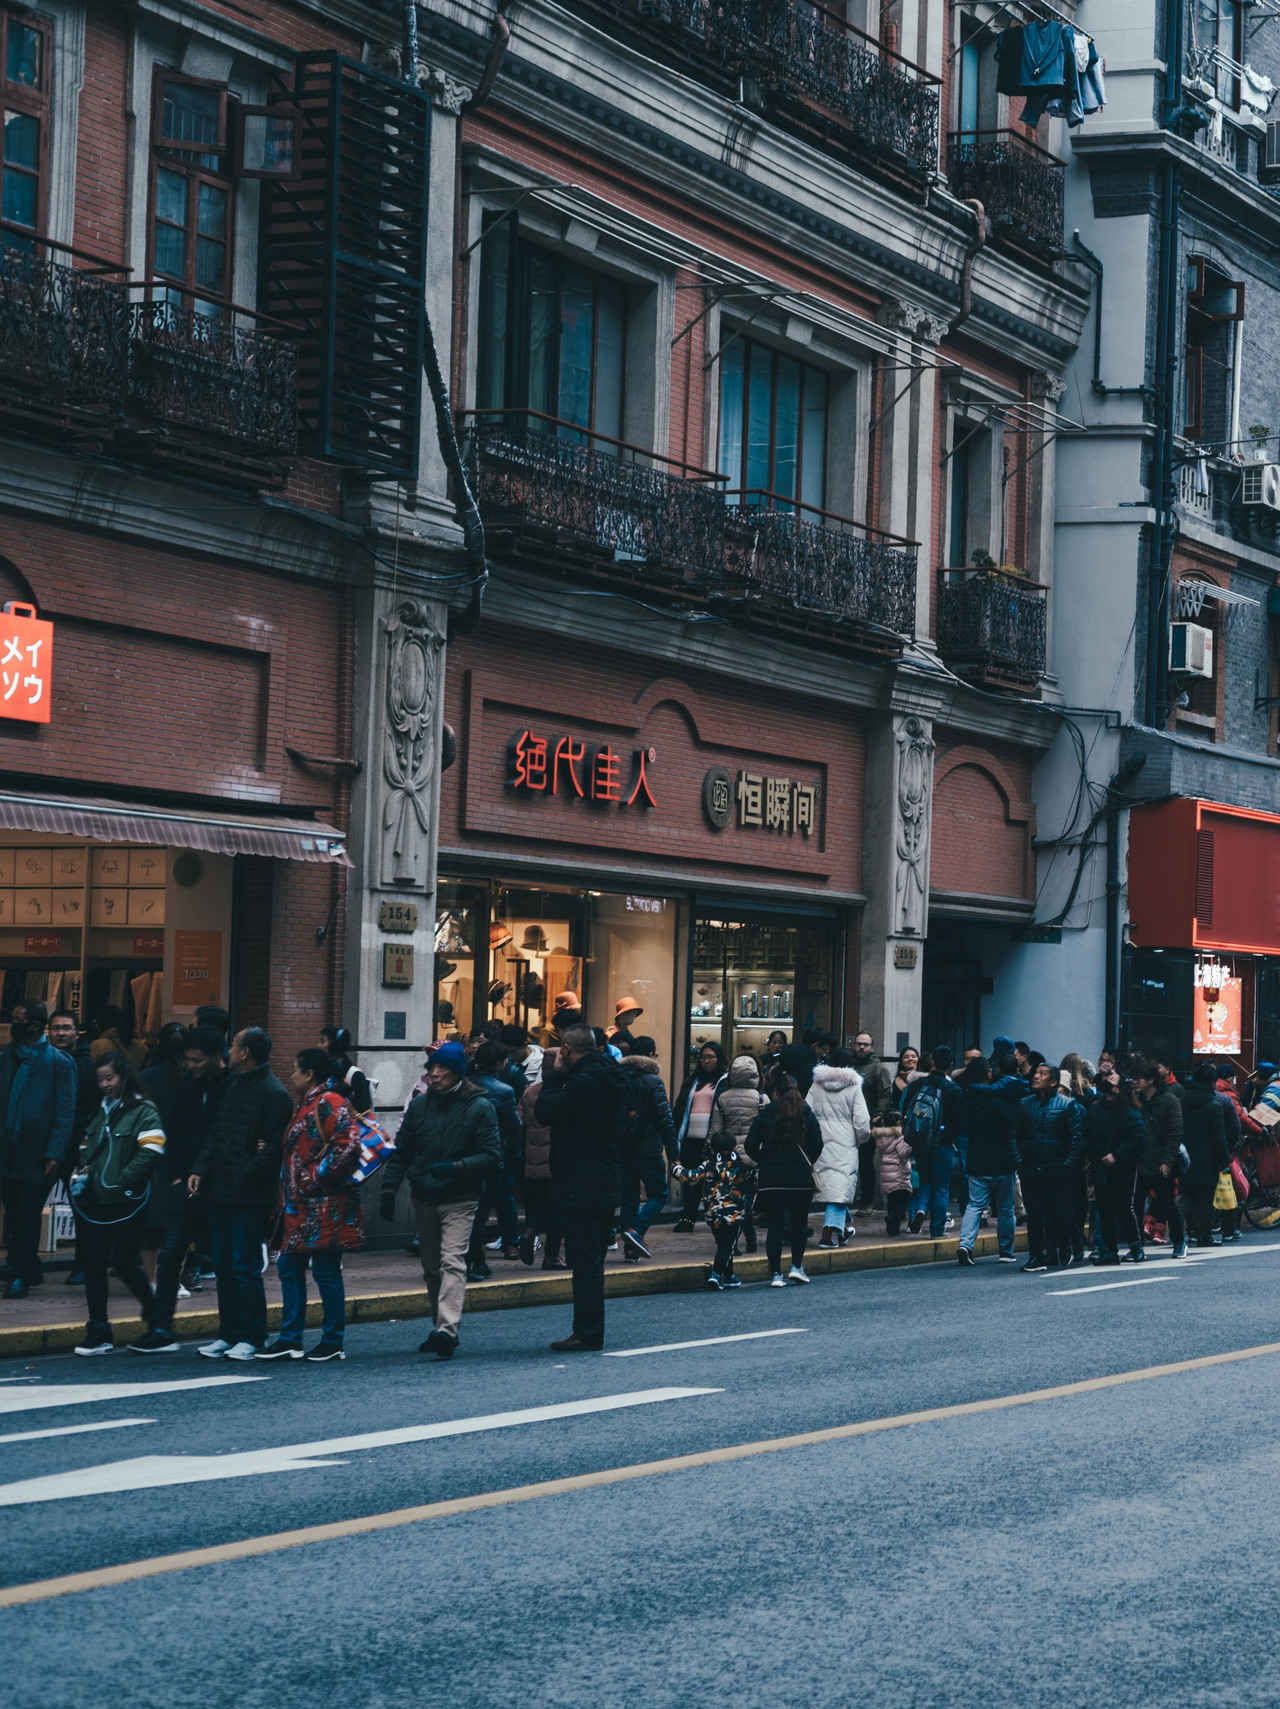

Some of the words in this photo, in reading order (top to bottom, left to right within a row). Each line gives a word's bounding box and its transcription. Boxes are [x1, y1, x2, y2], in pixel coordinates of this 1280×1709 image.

[513, 729, 658, 808] 绝代佳人
[388, 906, 411, 921] 154
[899, 949, 913, 960] 152
